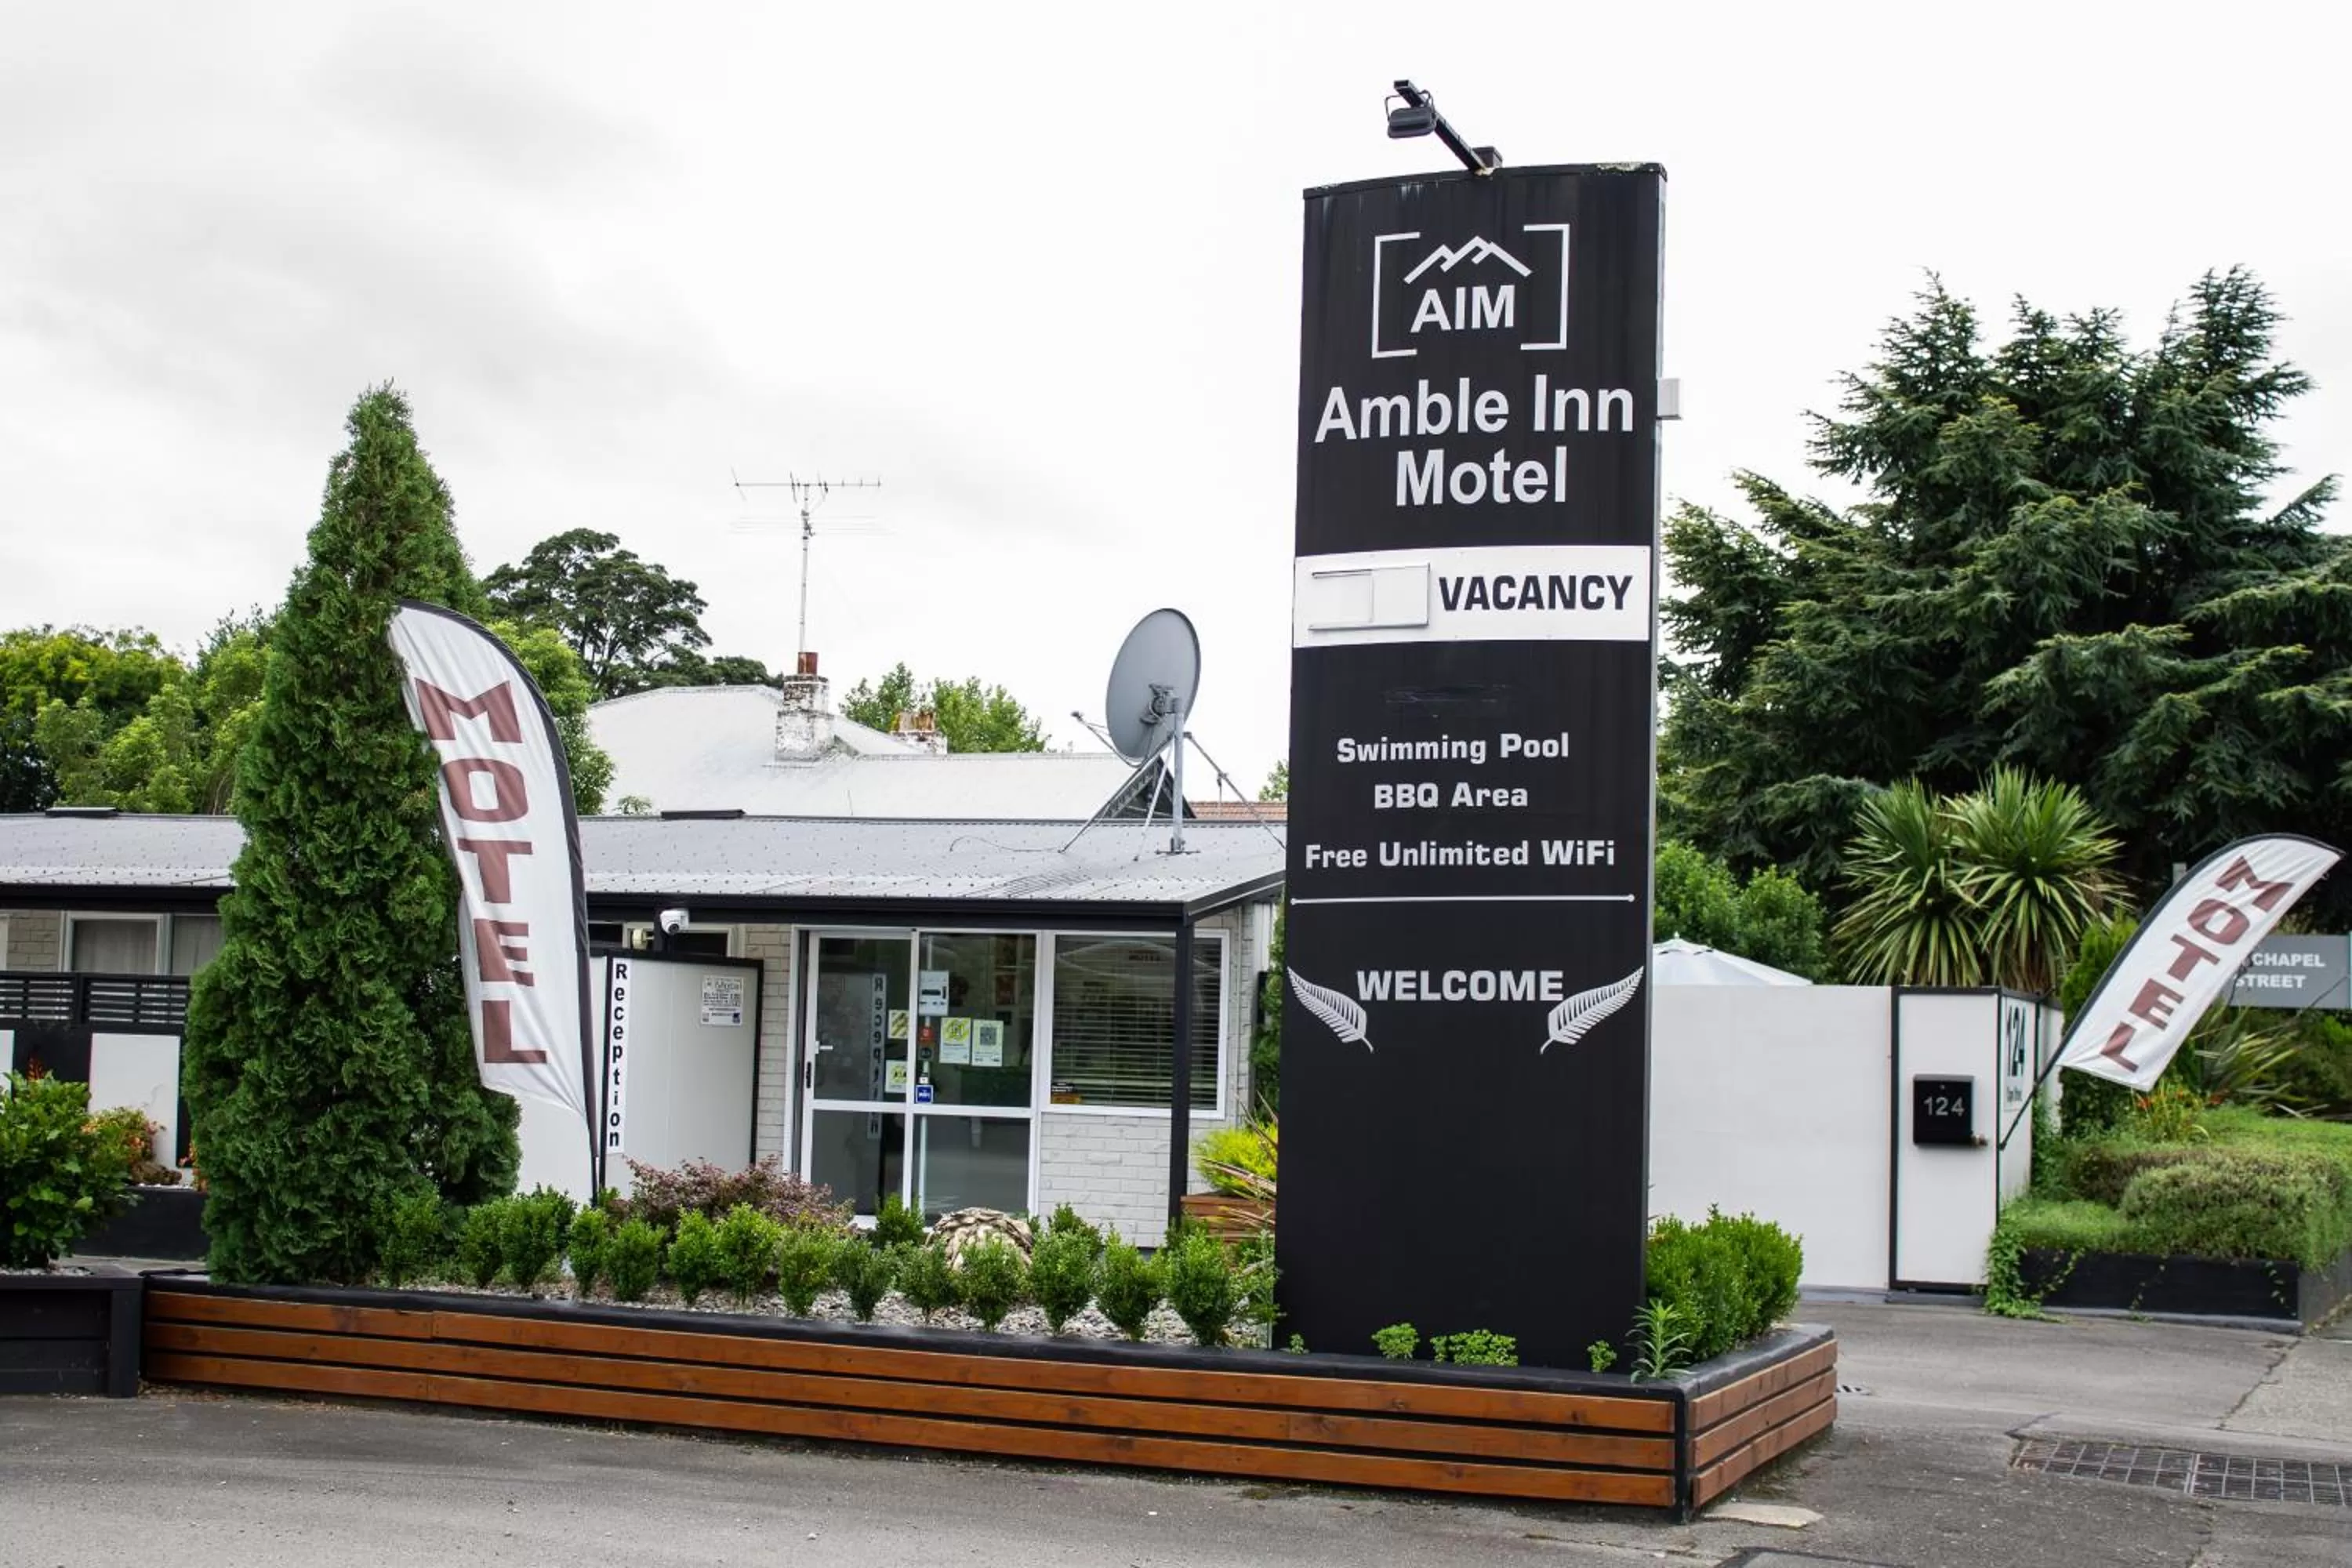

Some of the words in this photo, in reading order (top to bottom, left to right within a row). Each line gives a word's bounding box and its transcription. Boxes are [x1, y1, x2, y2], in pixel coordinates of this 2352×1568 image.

[1410, 285, 1515, 332] AIM
[1314, 377, 1508, 443] Amble
[1534, 375, 1633, 432] Inn
[1396, 446, 1567, 506] Motel
[1439, 575, 1632, 611] VACANCY
[1337, 735, 1486, 764] Swimming
[1500, 732, 1569, 758] Pool
[1374, 782, 1439, 808] BBQ
[1450, 782, 1528, 808] Area
[416, 678, 547, 1064] MOTEL
[1305, 844, 1367, 869] Free
[1379, 840, 1529, 867] Unlimited
[1541, 840, 1614, 866] WiFi
[2100, 856, 2292, 1073] MOTEL
[2252, 953, 2326, 967] CHAPEL
[1357, 970, 1564, 1001] WELCOME
[2235, 973, 2307, 989] STREET
[609, 964, 627, 1147] Reception
[2006, 1005, 2026, 1076] 124
[1924, 1096, 1965, 1116] 124
